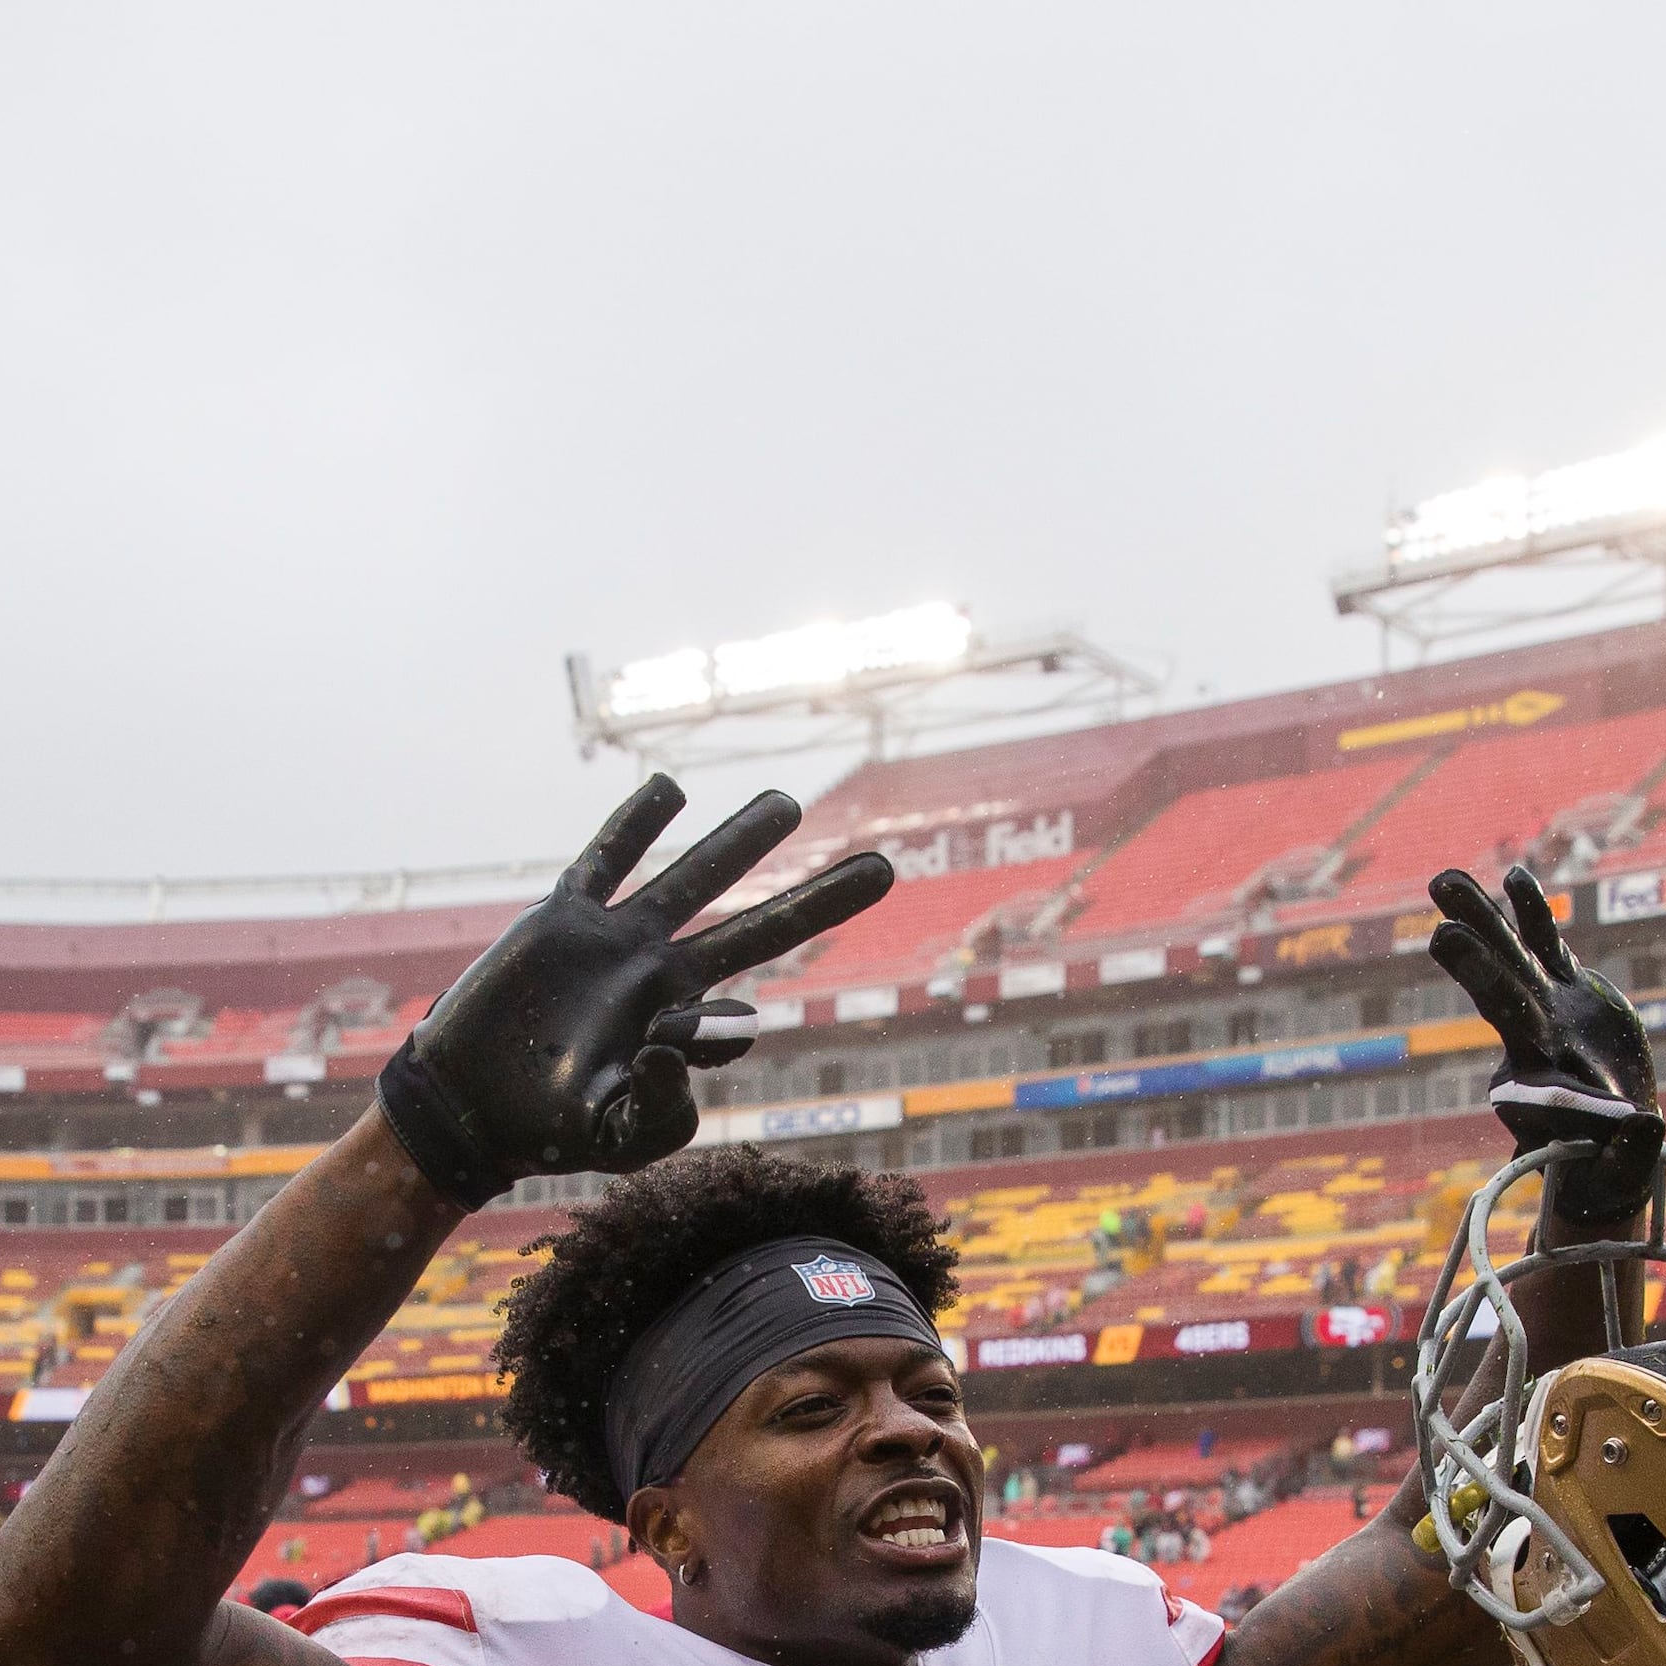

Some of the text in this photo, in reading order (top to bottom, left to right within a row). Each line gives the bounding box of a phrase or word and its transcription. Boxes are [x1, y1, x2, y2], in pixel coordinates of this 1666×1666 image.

[984, 810, 1074, 869] Field
[761, 1102, 862, 1136] GEICO
[812, 1274, 869, 1298] NFL
[978, 1334, 1087, 1368] REDSKINS
